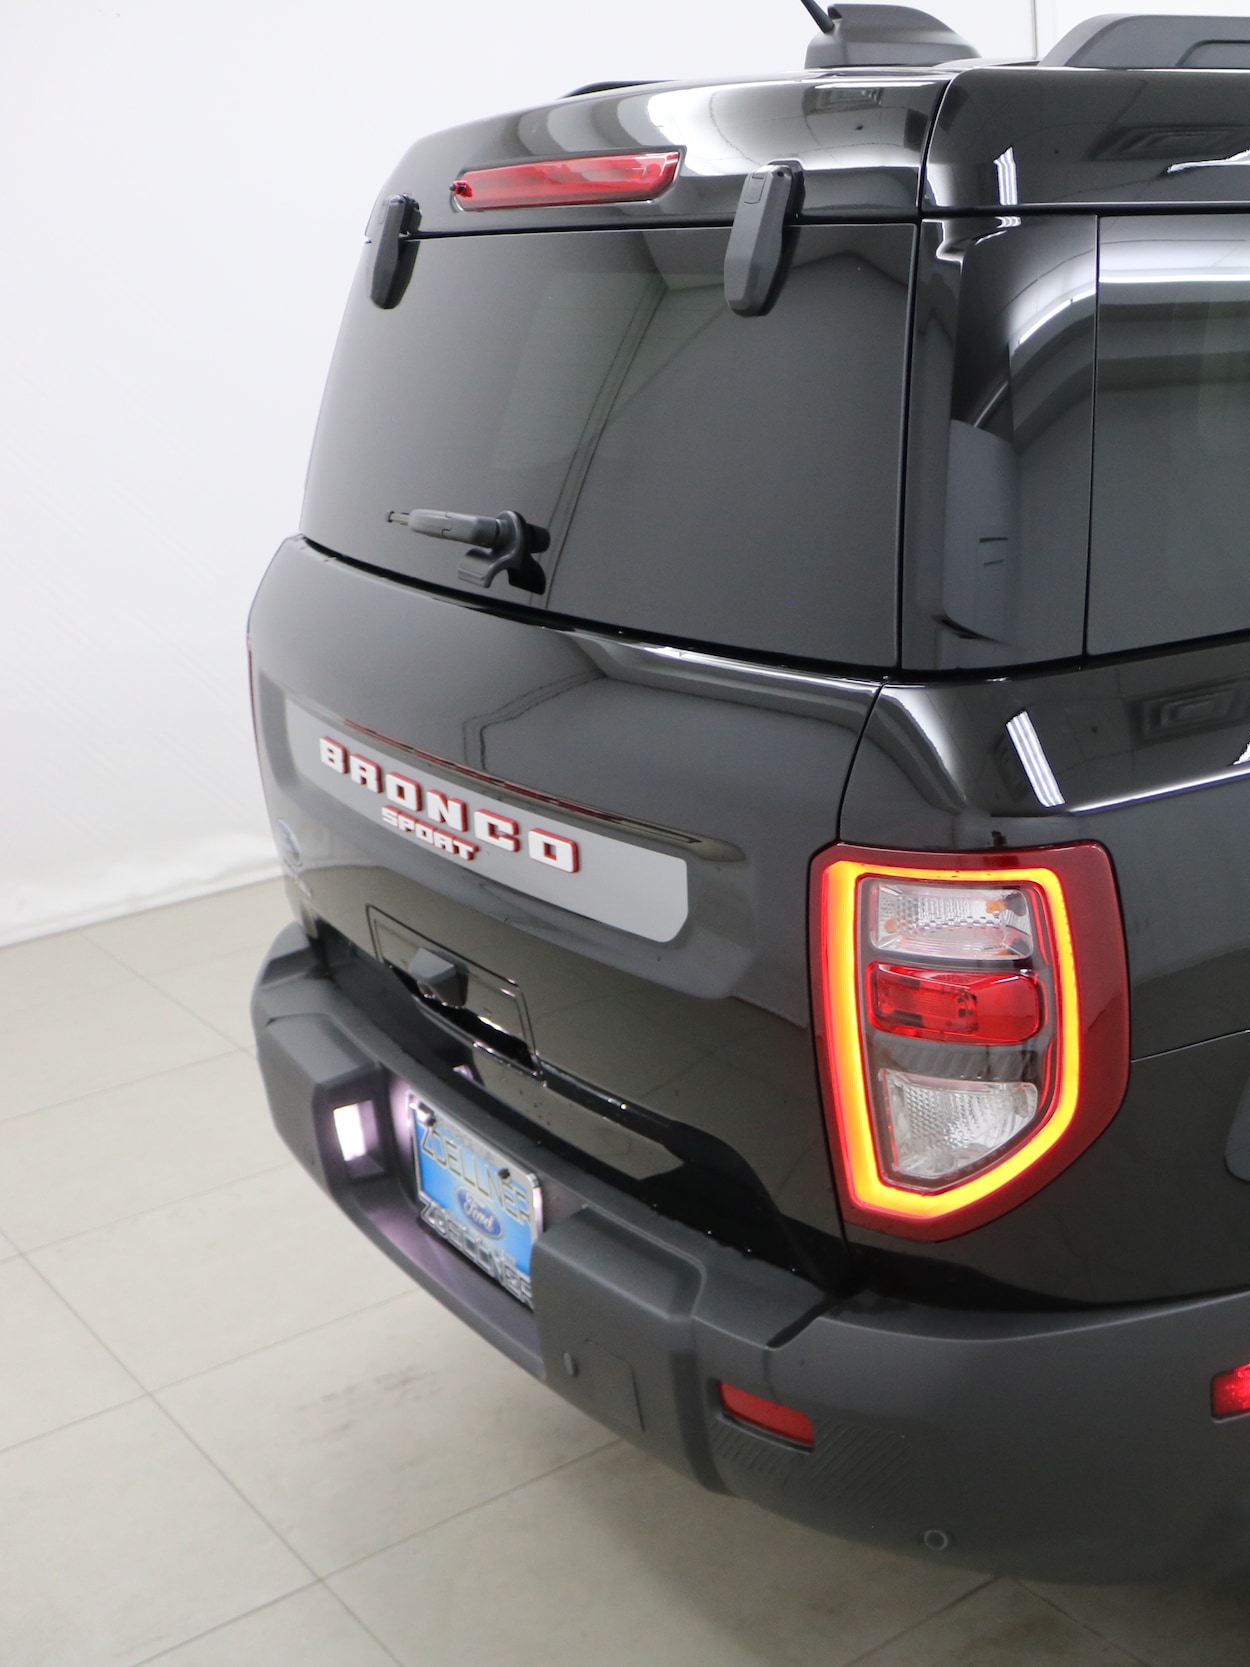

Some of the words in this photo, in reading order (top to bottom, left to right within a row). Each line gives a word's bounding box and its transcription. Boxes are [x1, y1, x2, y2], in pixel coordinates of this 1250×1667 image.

[318, 736, 580, 874] BRONCO
[380, 804, 480, 861] SPORT
[462, 1192, 495, 1233] Ford
